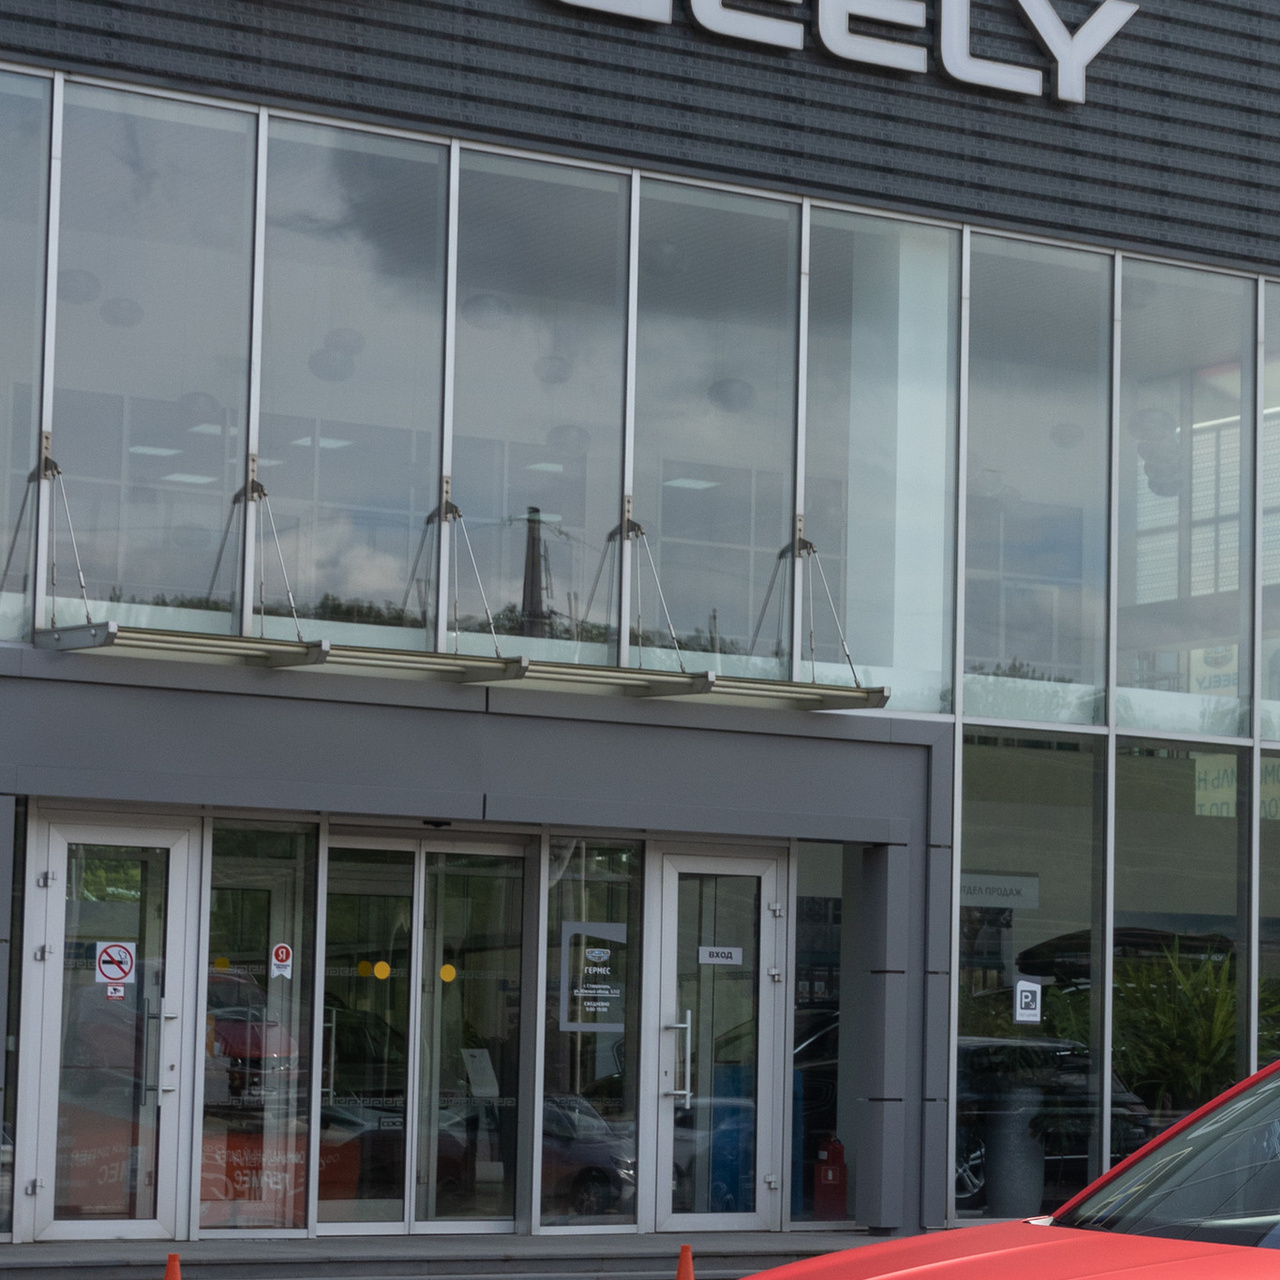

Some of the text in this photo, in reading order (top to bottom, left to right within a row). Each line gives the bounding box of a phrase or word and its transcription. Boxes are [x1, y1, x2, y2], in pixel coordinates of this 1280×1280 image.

[985, 886, 1023, 897] ПРОДАЖ
[708, 951, 733, 960] ВХОД
[584, 967, 611, 975] ГЕРМЕС
